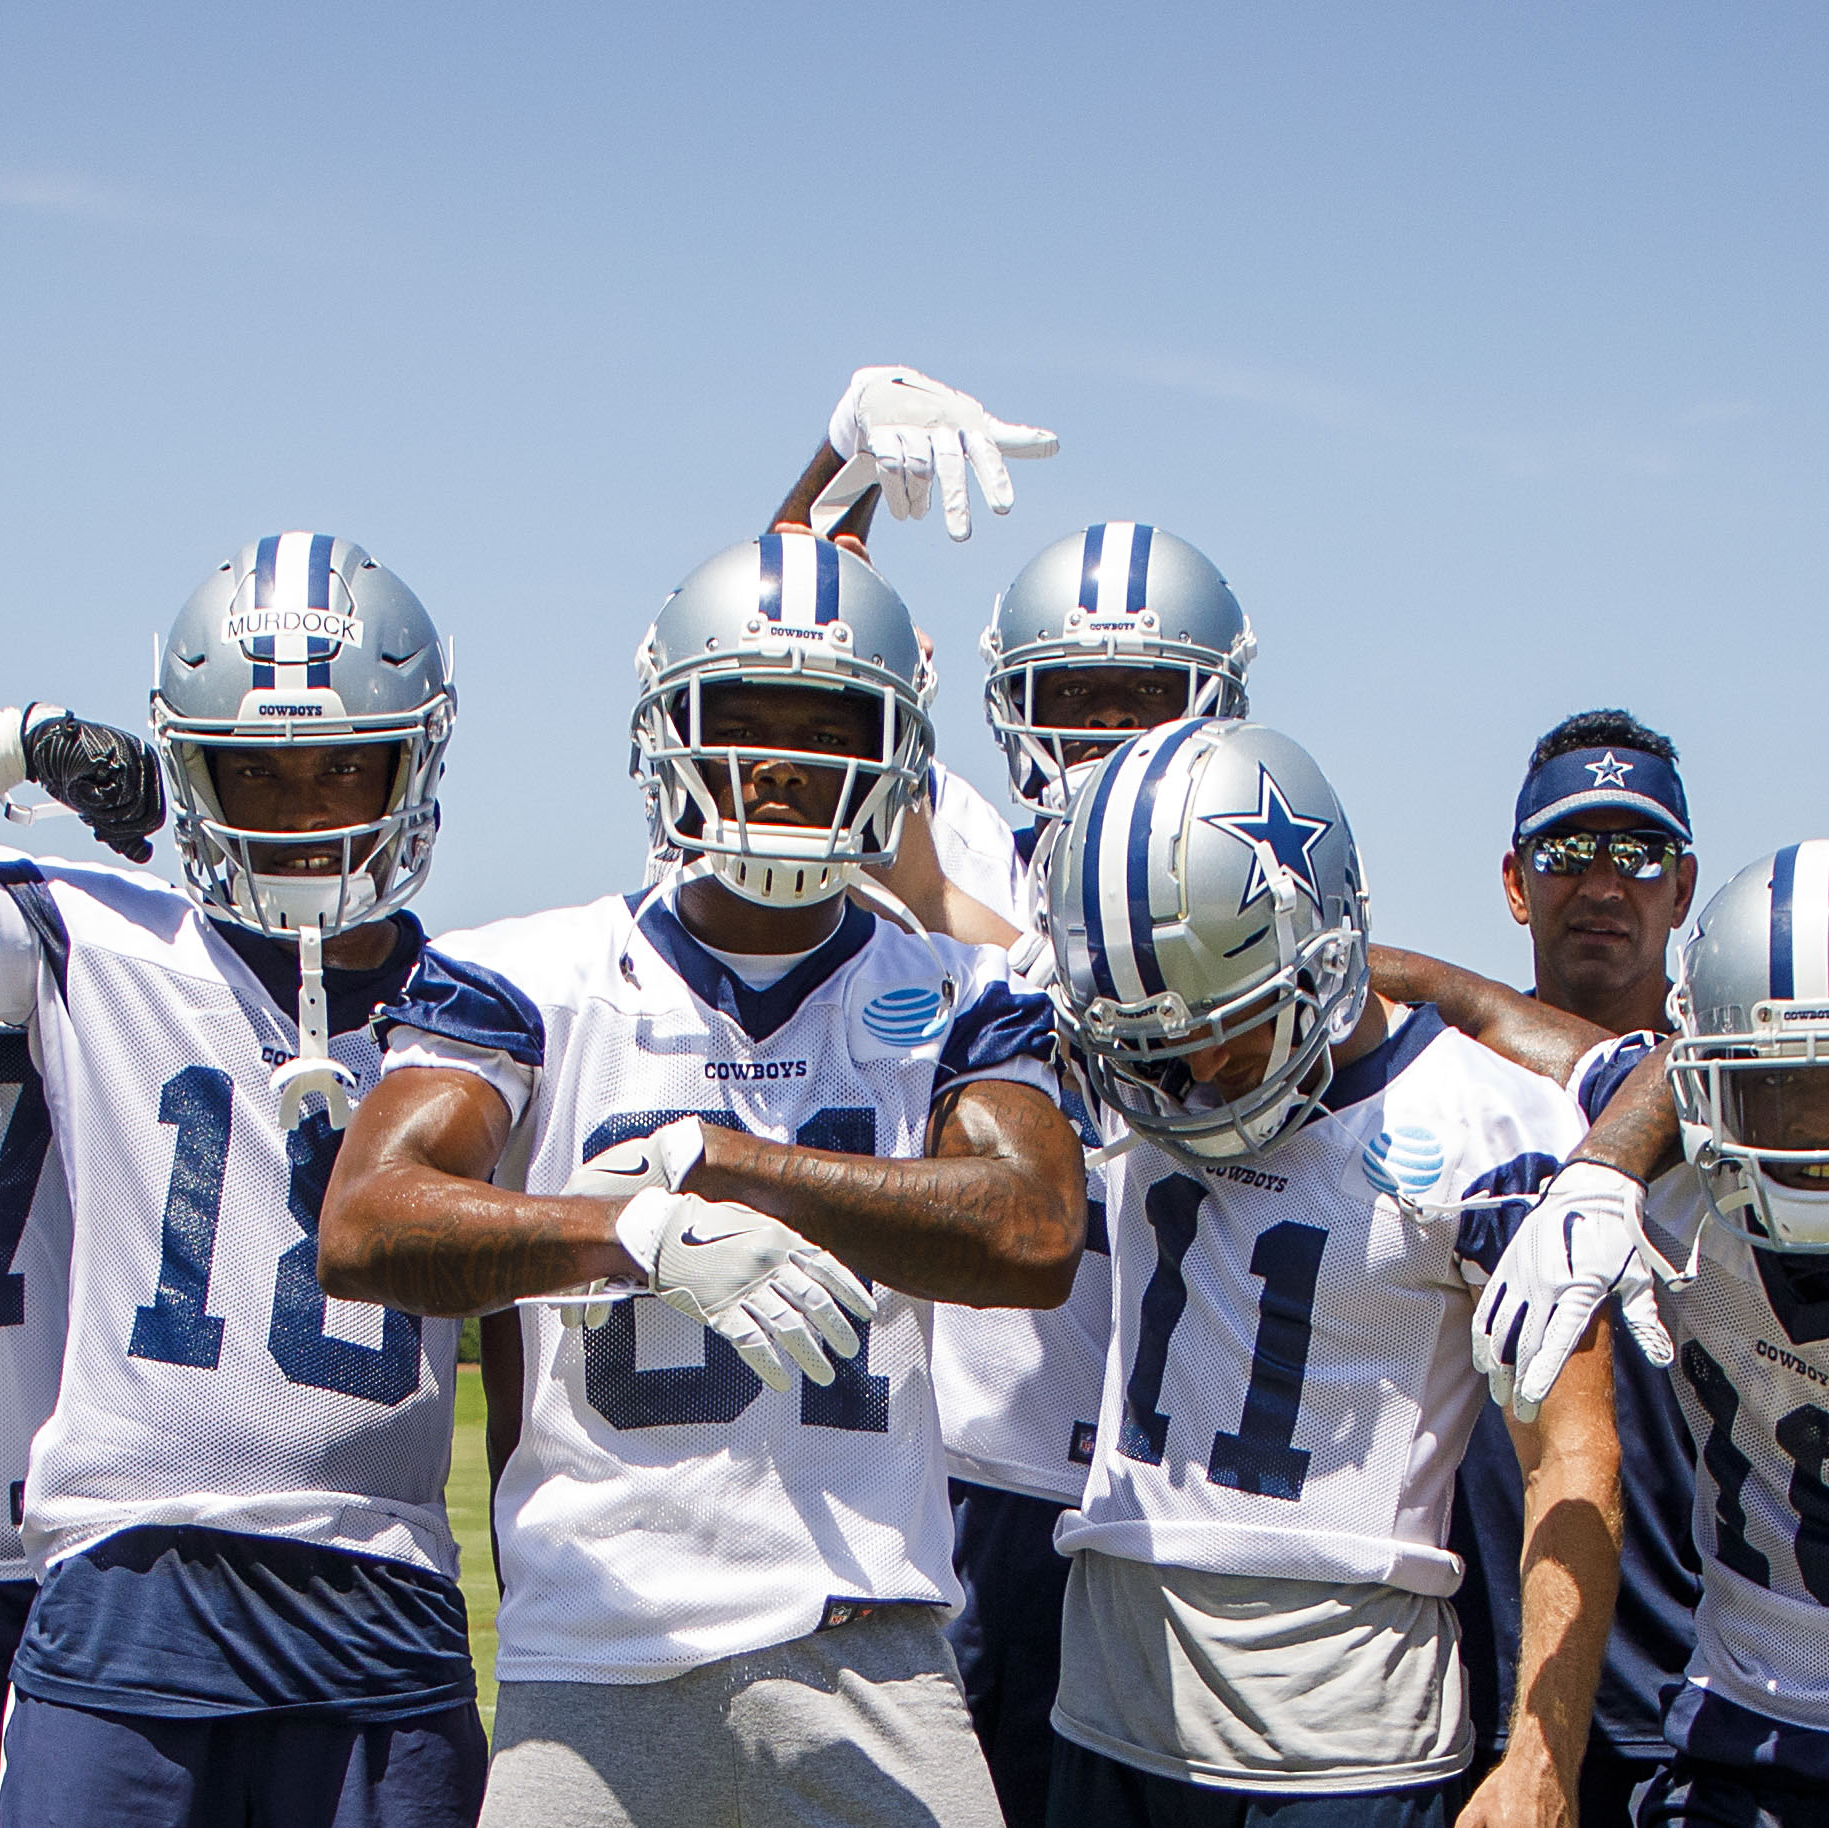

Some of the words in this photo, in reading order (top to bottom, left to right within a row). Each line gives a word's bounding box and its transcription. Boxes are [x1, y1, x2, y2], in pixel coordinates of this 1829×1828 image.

[228, 611, 358, 640] MURDOCK
[770, 626, 824, 641] COWBOYS
[1089, 622, 1136, 632] COWBOYS
[258, 704, 323, 717] COWBOYS
[704, 1059, 807, 1081] COWBOYS
[127, 1064, 423, 1407] 18
[1115, 1171, 1329, 1503] 11
